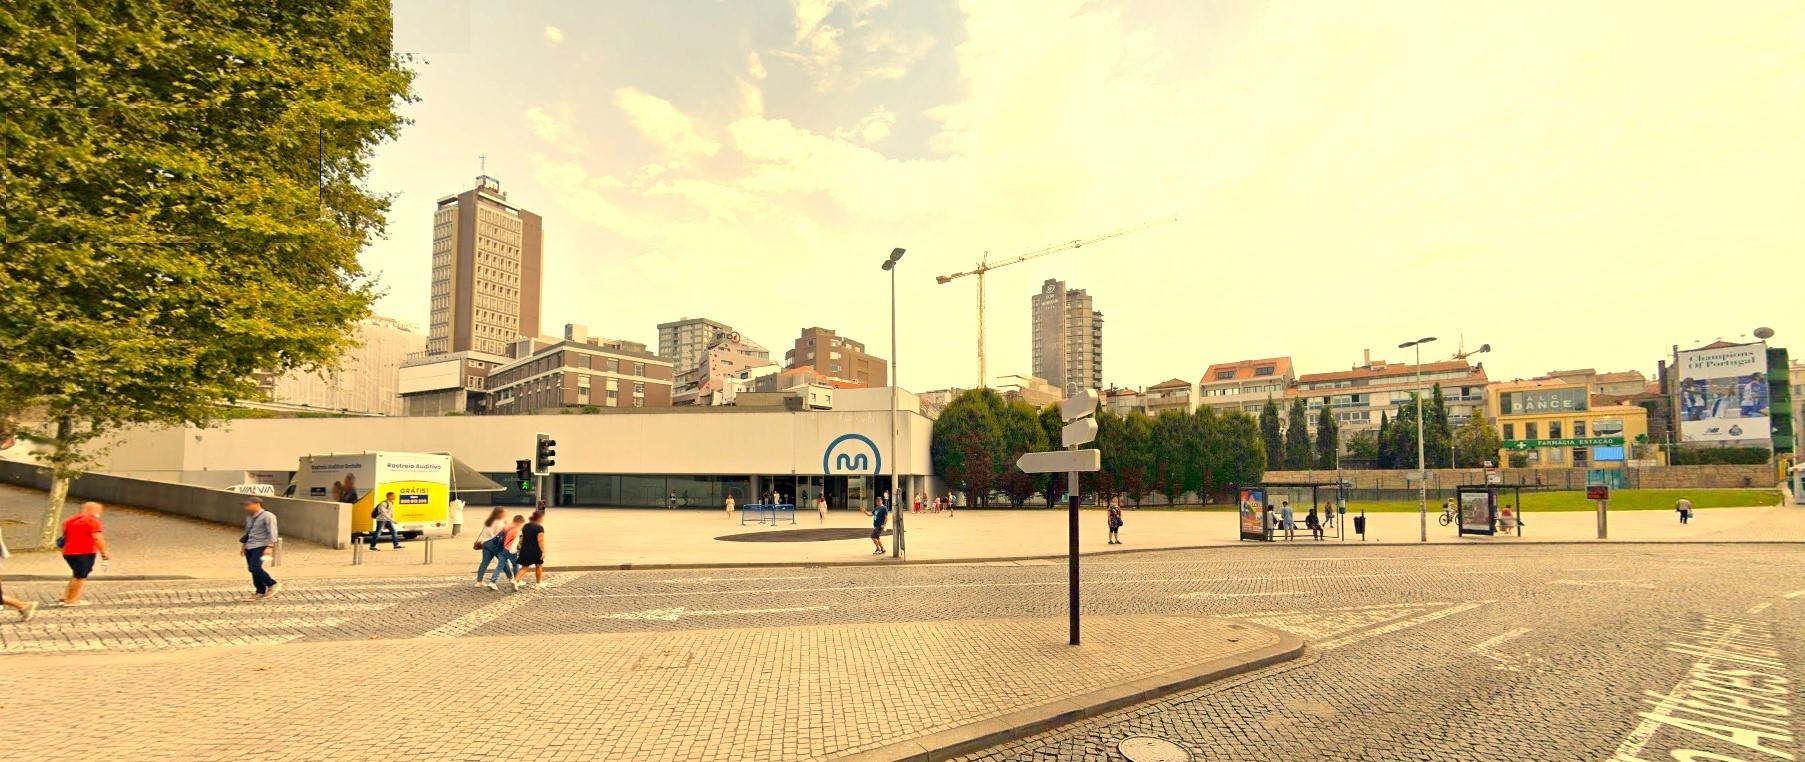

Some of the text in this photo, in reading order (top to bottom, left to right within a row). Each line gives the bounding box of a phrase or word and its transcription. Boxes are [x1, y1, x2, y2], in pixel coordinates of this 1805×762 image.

[1689, 351, 1754, 362] Champions
[1706, 356, 1756, 368] Portugal
[1513, 399, 1573, 410] DANCE
[1579, 437, 1614, 445] ESTAÇÃO
[400, 486, 429, 494] GRÁTIS!
